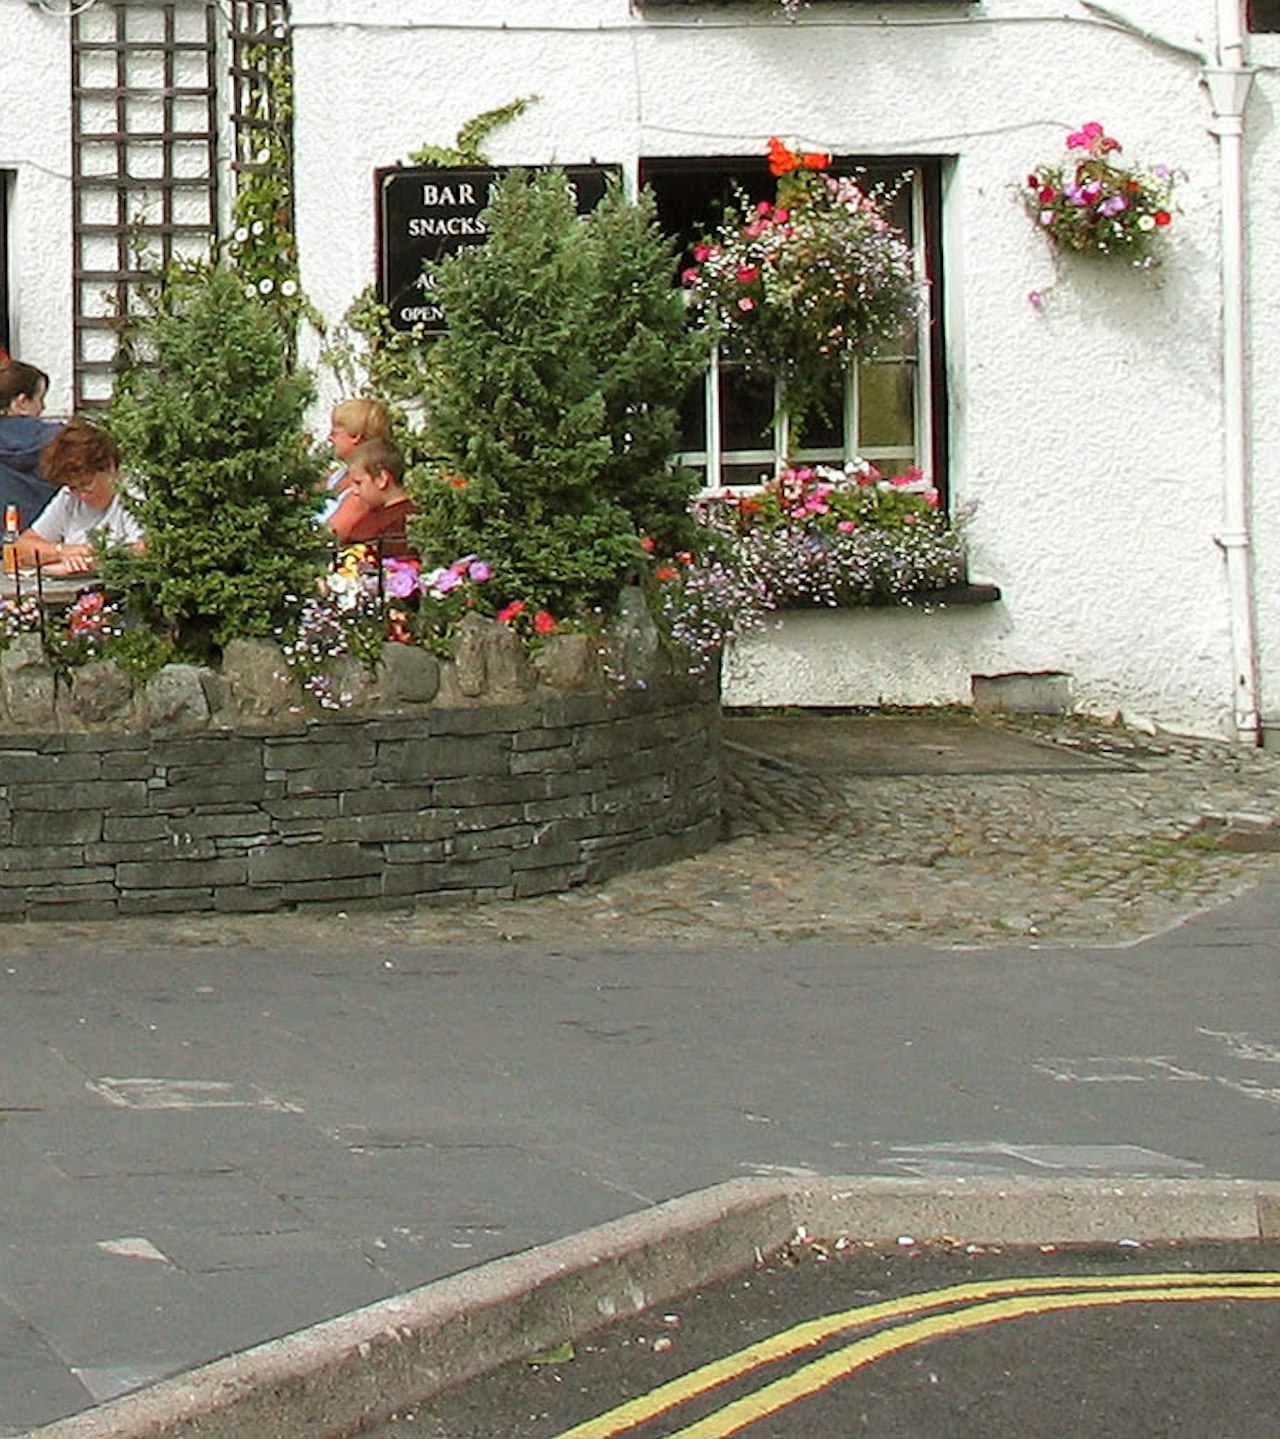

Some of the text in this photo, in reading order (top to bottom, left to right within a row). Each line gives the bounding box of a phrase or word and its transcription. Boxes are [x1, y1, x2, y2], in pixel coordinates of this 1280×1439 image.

[423, 183, 476, 206] BAR
[408, 217, 486, 237] SNACKS
[400, 306, 444, 322] OPEN
